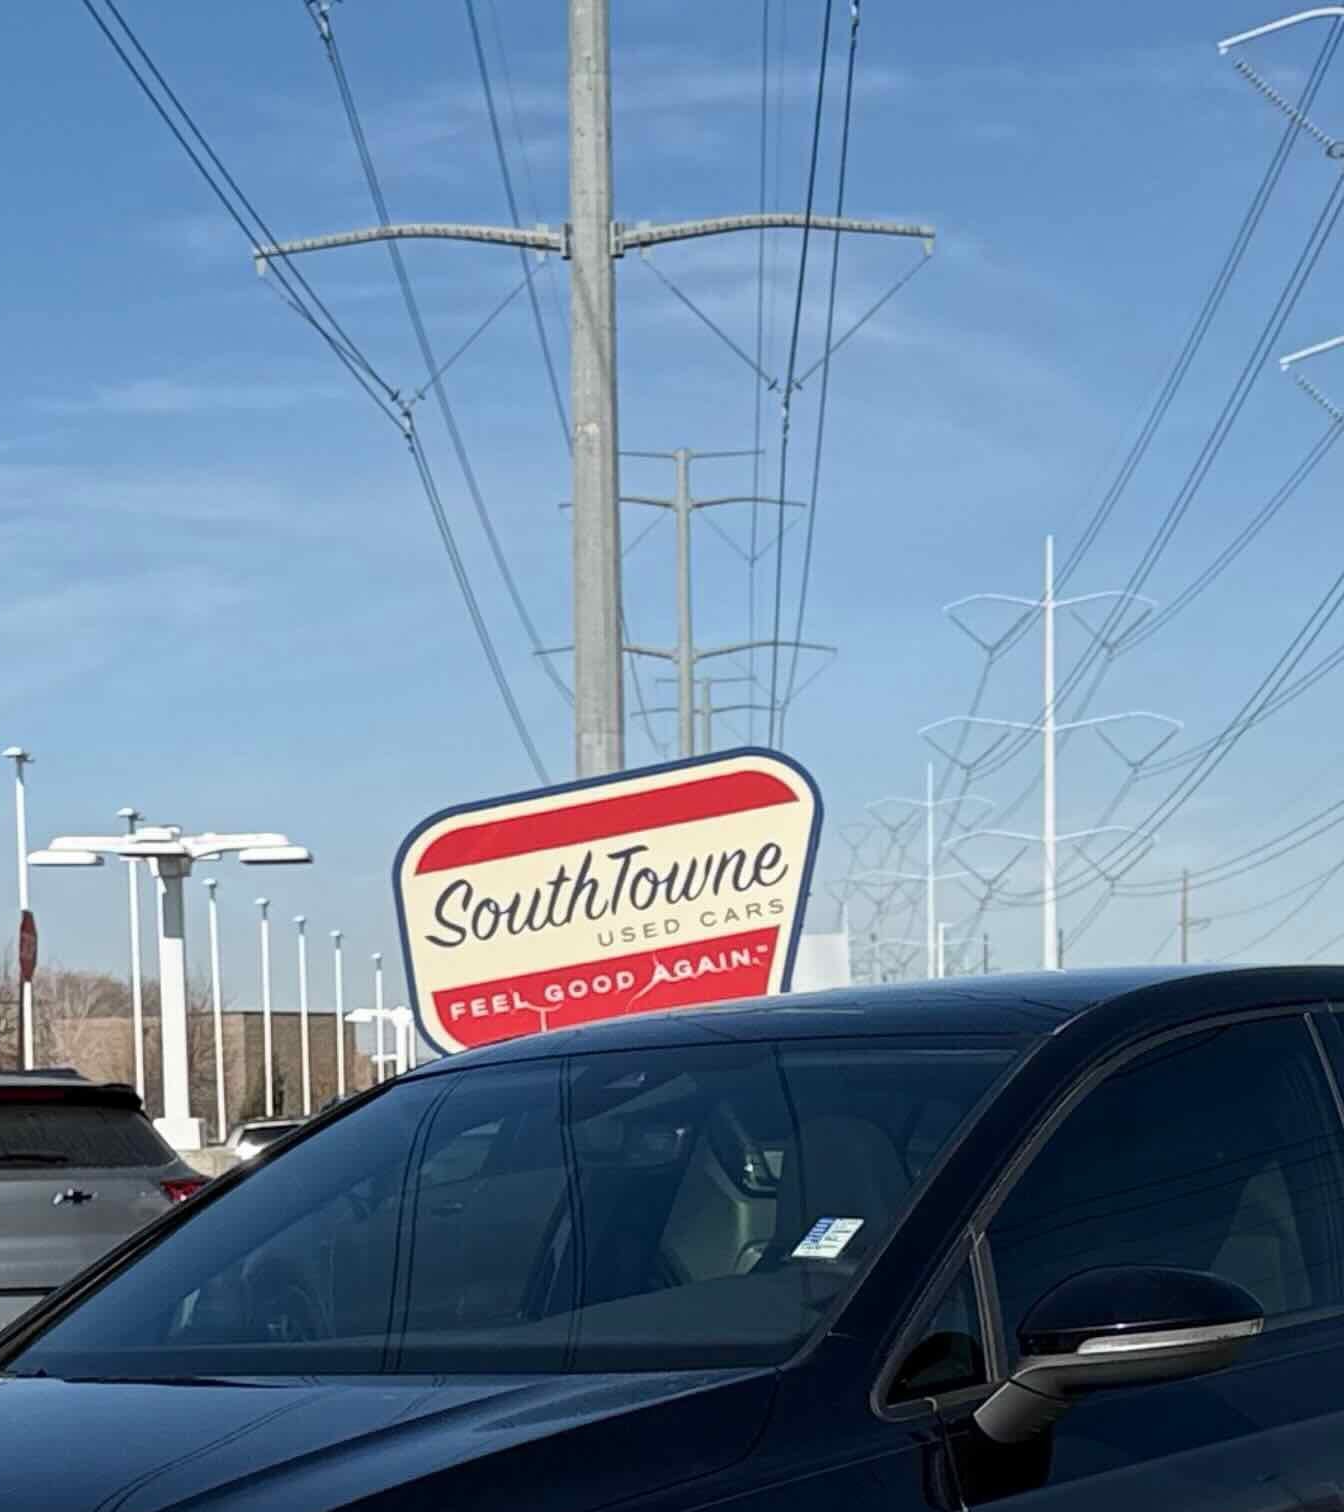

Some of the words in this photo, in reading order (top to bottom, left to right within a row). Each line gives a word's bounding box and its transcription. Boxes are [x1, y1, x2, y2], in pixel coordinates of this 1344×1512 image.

[597, 917, 681, 947] USED
[699, 897, 786, 928] CARS
[449, 990, 529, 1021] FEEL
[544, 969, 636, 1003] GOOD
